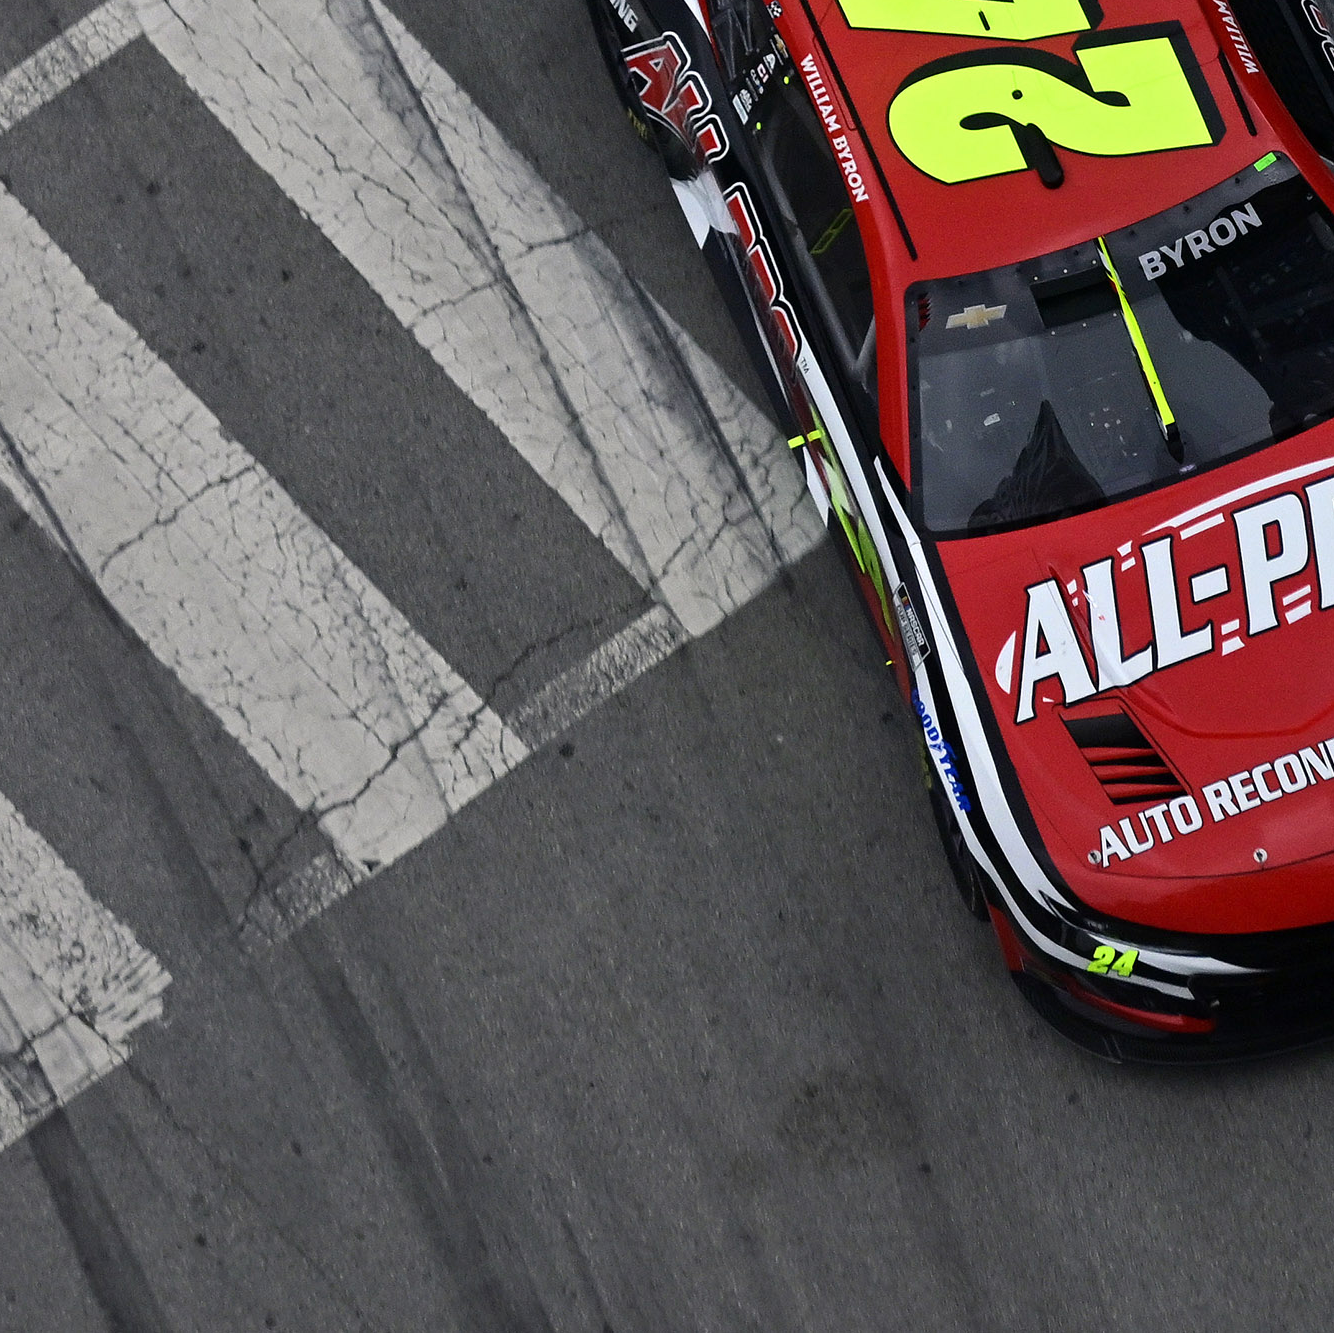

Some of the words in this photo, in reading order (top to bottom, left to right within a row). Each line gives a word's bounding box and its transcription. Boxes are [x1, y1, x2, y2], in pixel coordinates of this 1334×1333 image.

[800, 53, 841, 133] WILLIAM
[833, 136, 868, 203] BYRON
[1138, 202, 1263, 281] BYRON
[906, 607, 925, 647] NASCAR
[911, 687, 971, 812] GOODYEAR
[1097, 795, 1204, 869] AUTO
[1087, 945, 1141, 978] 24
